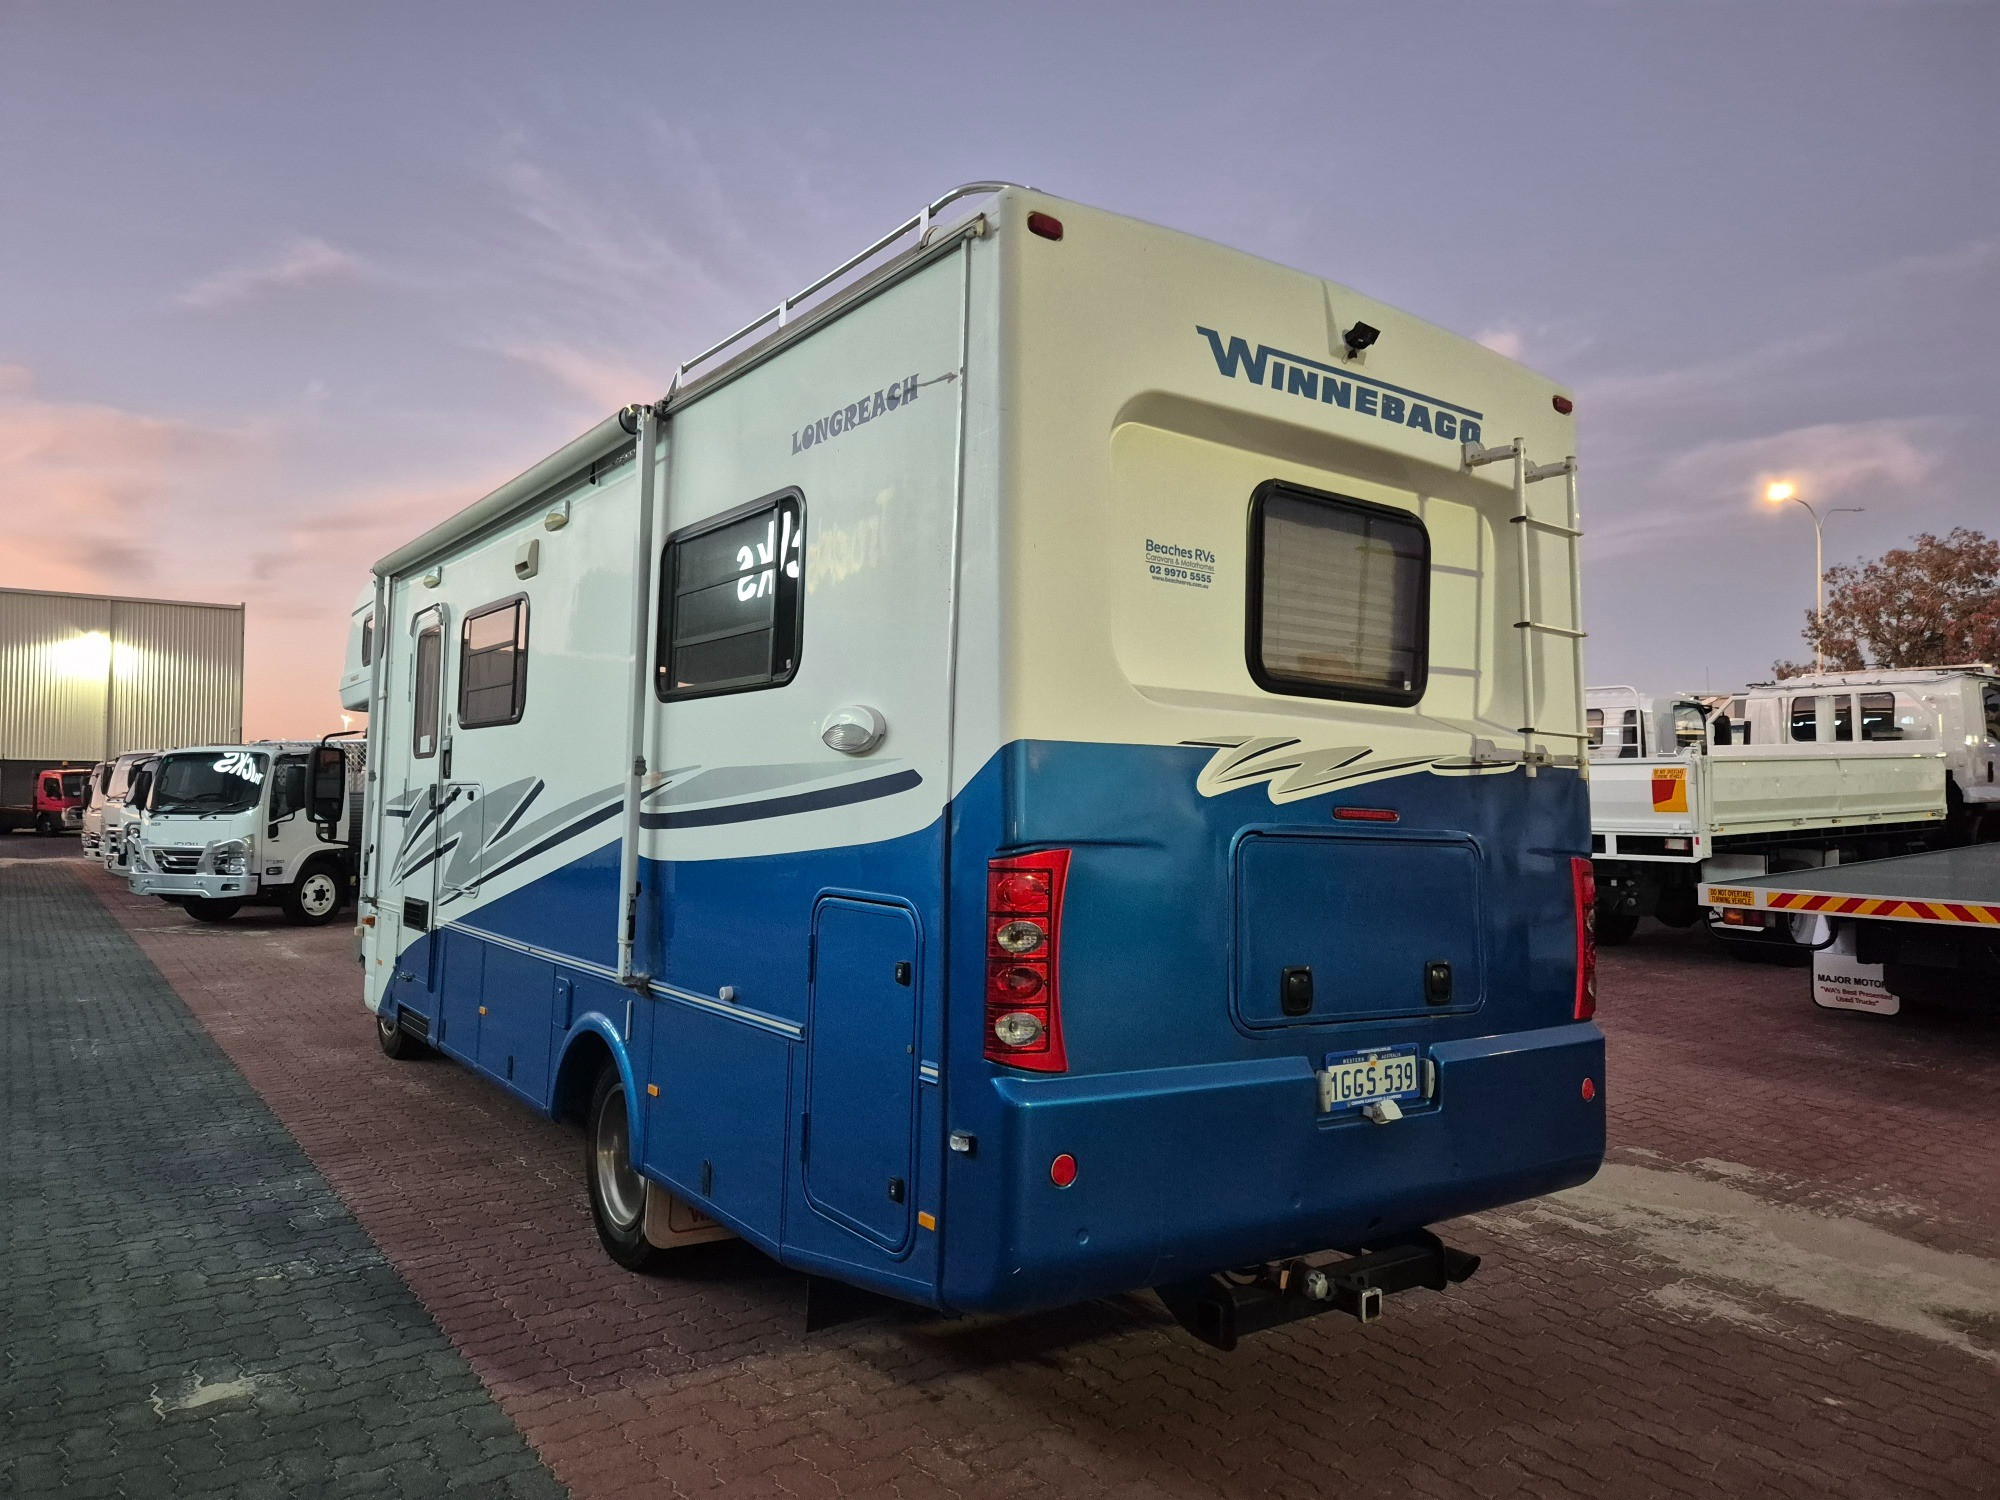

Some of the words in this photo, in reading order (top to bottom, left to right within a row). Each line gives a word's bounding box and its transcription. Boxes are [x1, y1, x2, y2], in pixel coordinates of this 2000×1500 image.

[1195, 325, 1483, 444] WINNEBAGO
[791, 373, 919, 456] LONGREACH
[1145, 539, 1193, 559] Beaches
[1195, 548, 1216, 563] RVs
[1145, 553, 1174, 565] Caravans
[1181, 560, 1215, 572] Motorhomes
[1149, 565, 1162, 575] 02
[1164, 567, 1188, 579] 9970
[1190, 572, 1212, 583] 5555
[1711, 896, 1730, 904] TURNING
[1731, 897, 1752, 905] VEHICLE
[1718, 889, 1727, 897] NOT
[1728, 890, 1752, 898] OVERTAKE
[1817, 974, 1851, 985] MAJOR
[1854, 978, 1885, 988] MOTO
